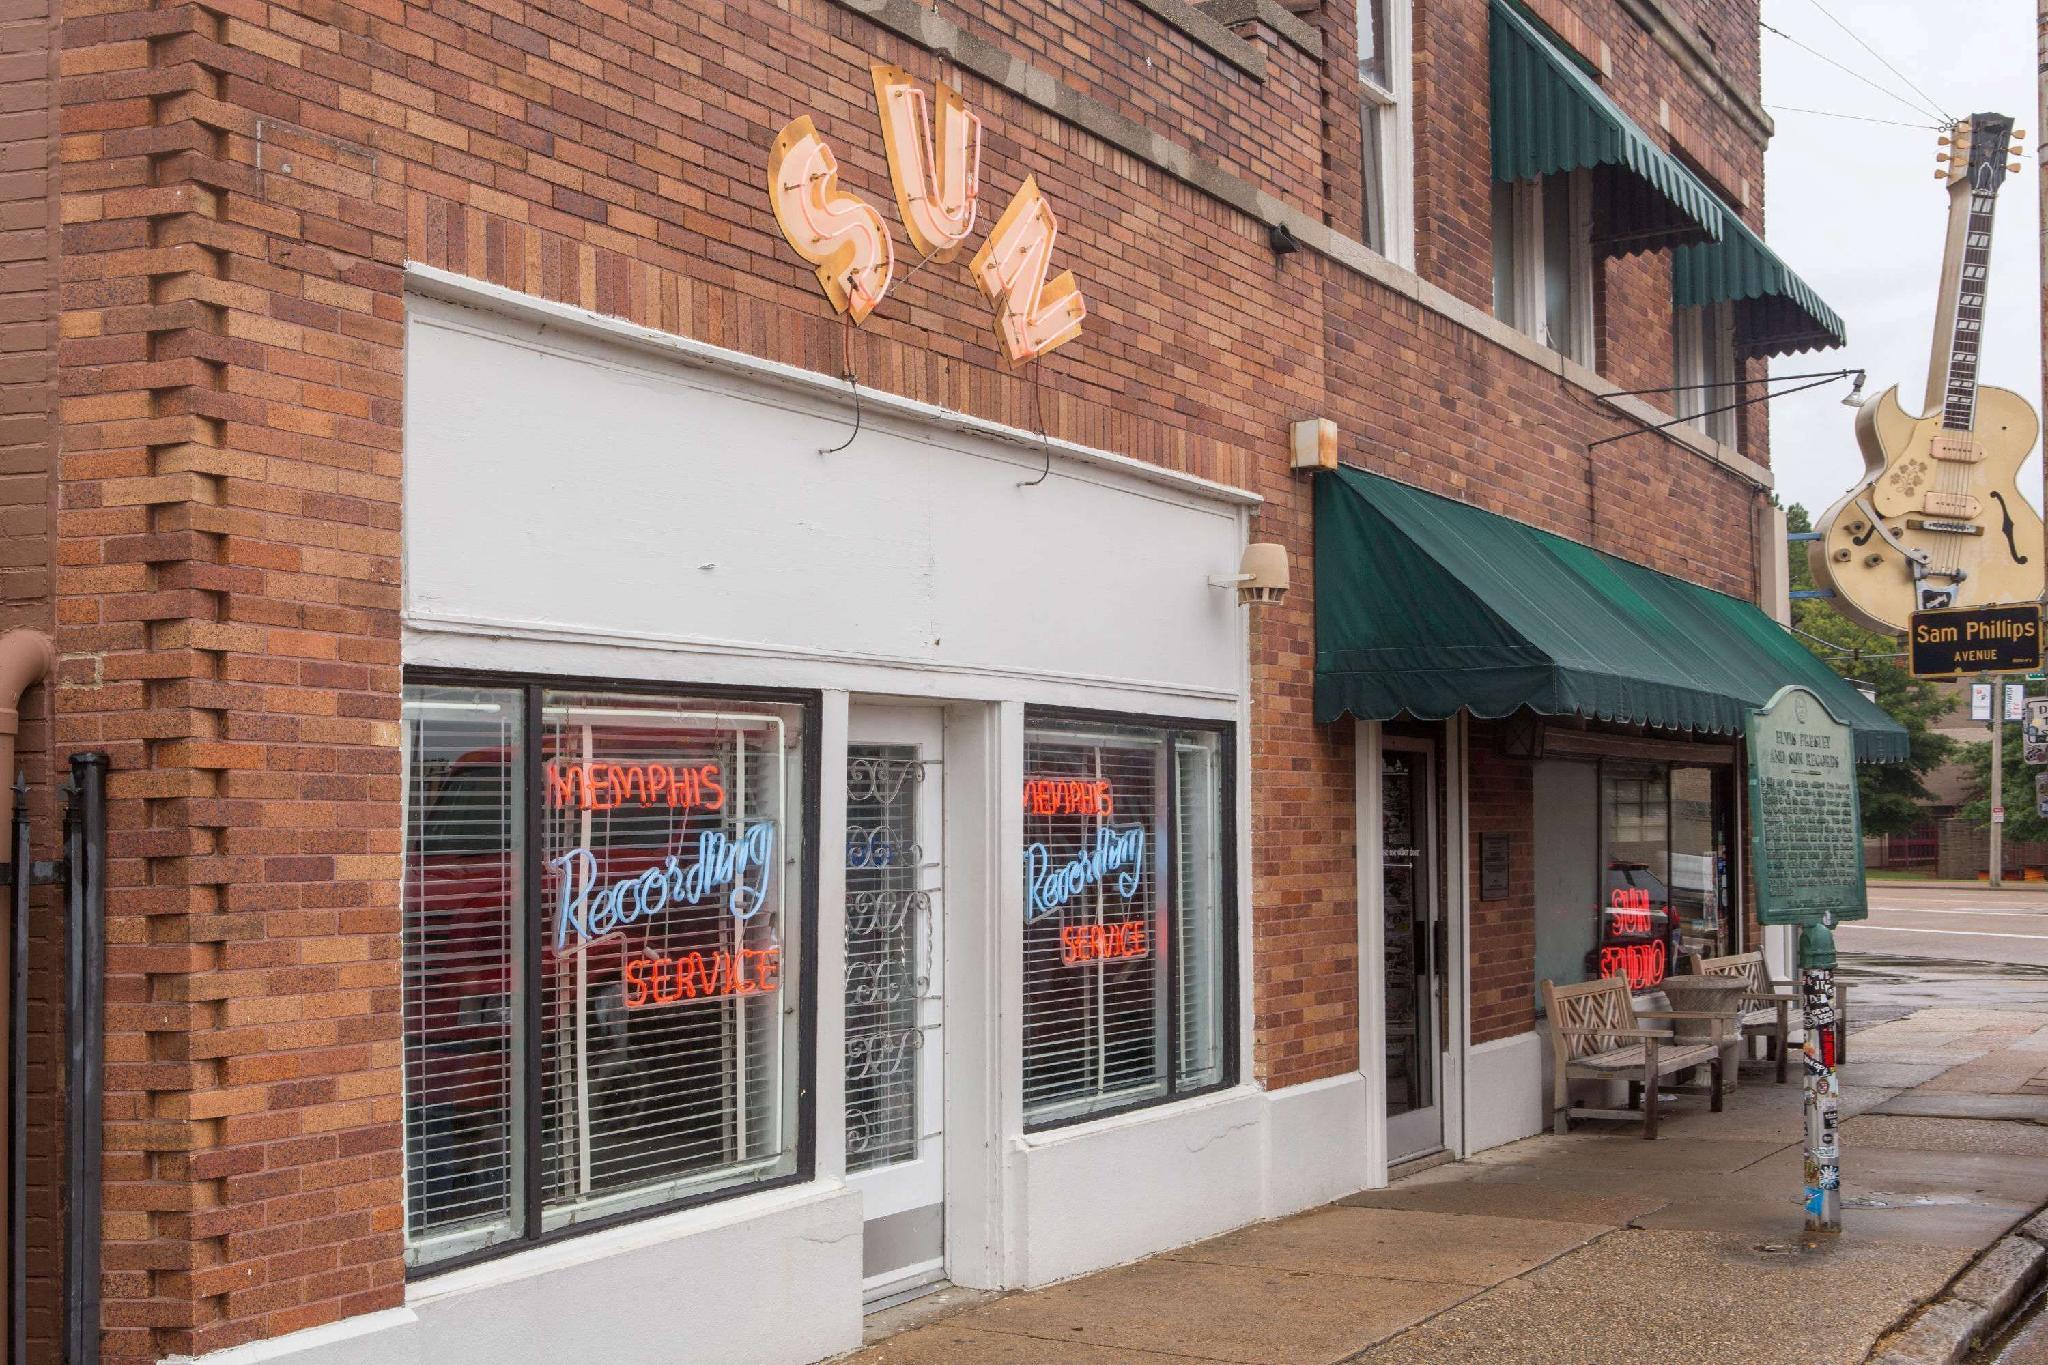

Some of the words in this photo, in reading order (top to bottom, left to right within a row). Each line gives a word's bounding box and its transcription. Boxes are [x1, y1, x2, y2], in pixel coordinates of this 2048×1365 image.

[768, 65, 1086, 370] SUN
[1917, 623, 1958, 643] Sam
[1966, 619, 2035, 642] Phillips
[1954, 649, 1998, 662] AVENUE
[546, 762, 725, 811] MEMPHIS
[548, 820, 776, 953] Recording
[1023, 827, 1144, 922] Recording
[1612, 888, 1651, 935] SUN
[1062, 920, 1147, 962] SERVICE
[1601, 939, 1665, 989] STUDIO
[625, 948, 781, 1008] SERVICE
